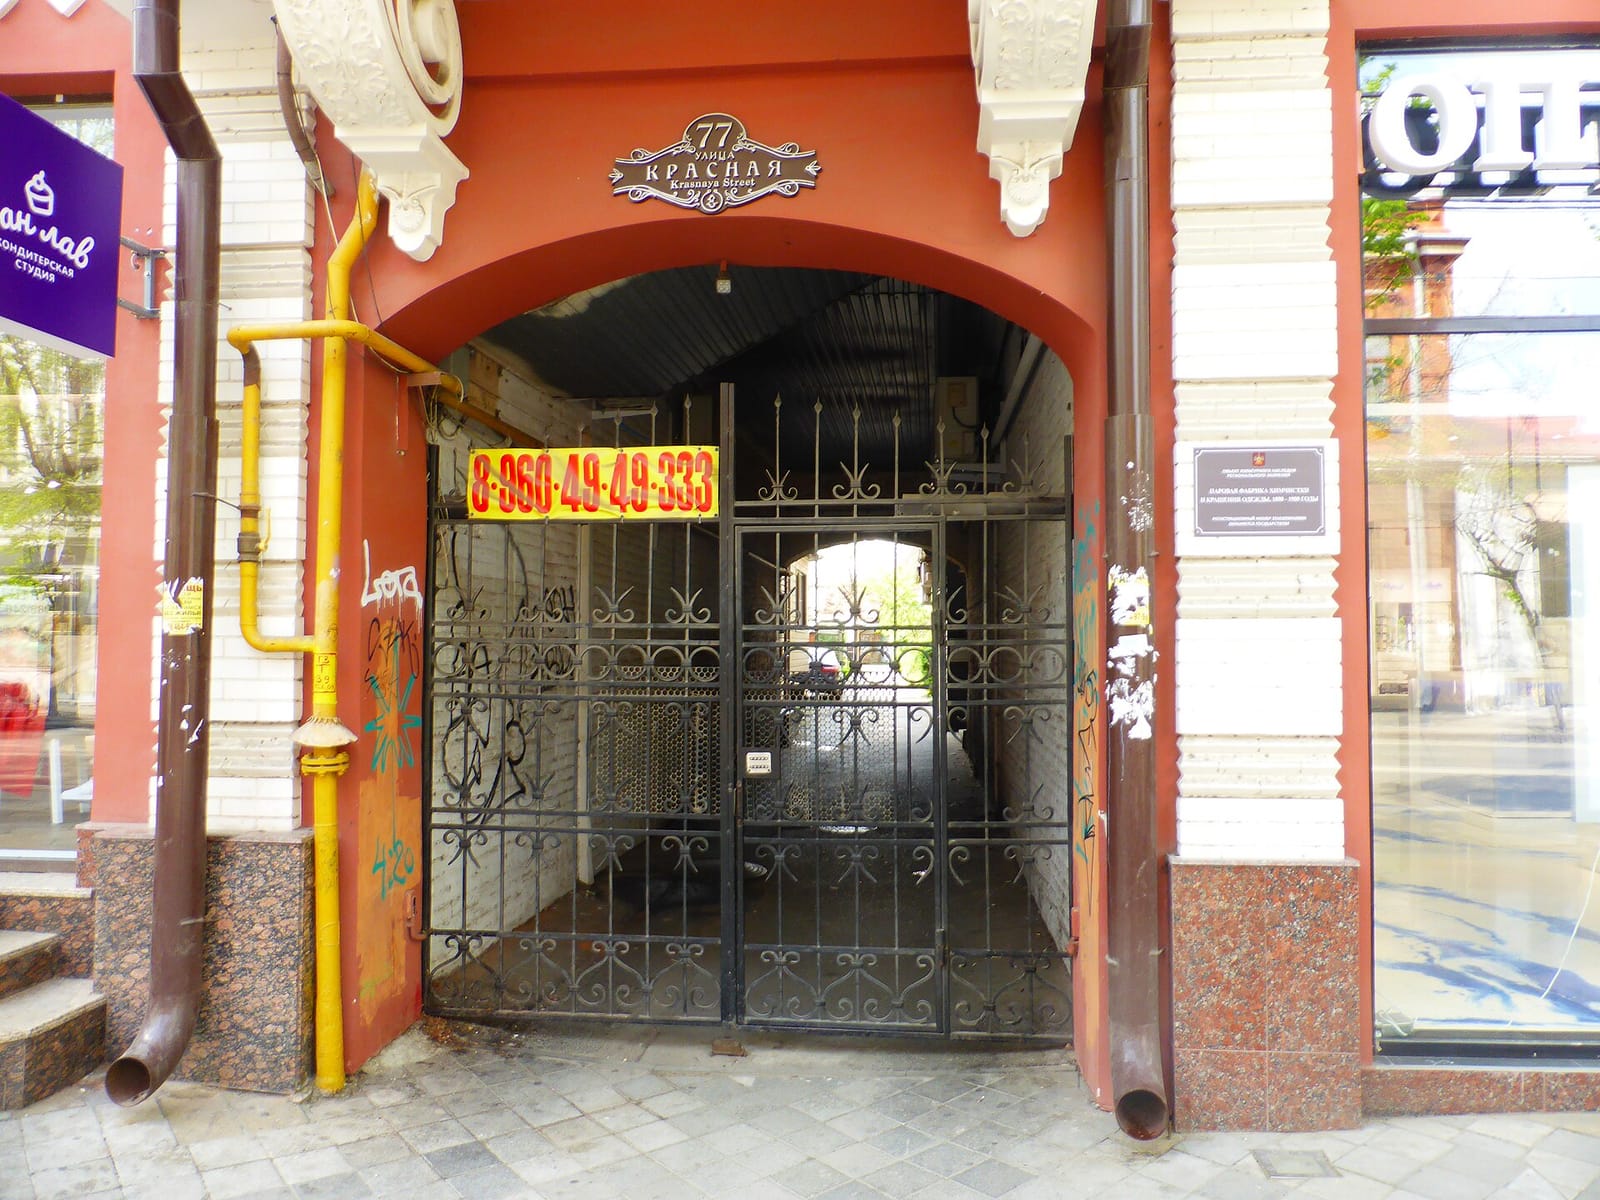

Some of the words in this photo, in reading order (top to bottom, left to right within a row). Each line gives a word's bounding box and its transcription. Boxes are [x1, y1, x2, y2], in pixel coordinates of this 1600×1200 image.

[695, 122, 733, 149] 77
[695, 151, 735, 161] УЛИЦА
[646, 160, 782, 181] КРАСНАЯ
[670, 179, 720, 189] Krasnaya
[722, 178, 756, 188] Street
[15, 258, 56, 283] СТУДИЯ
